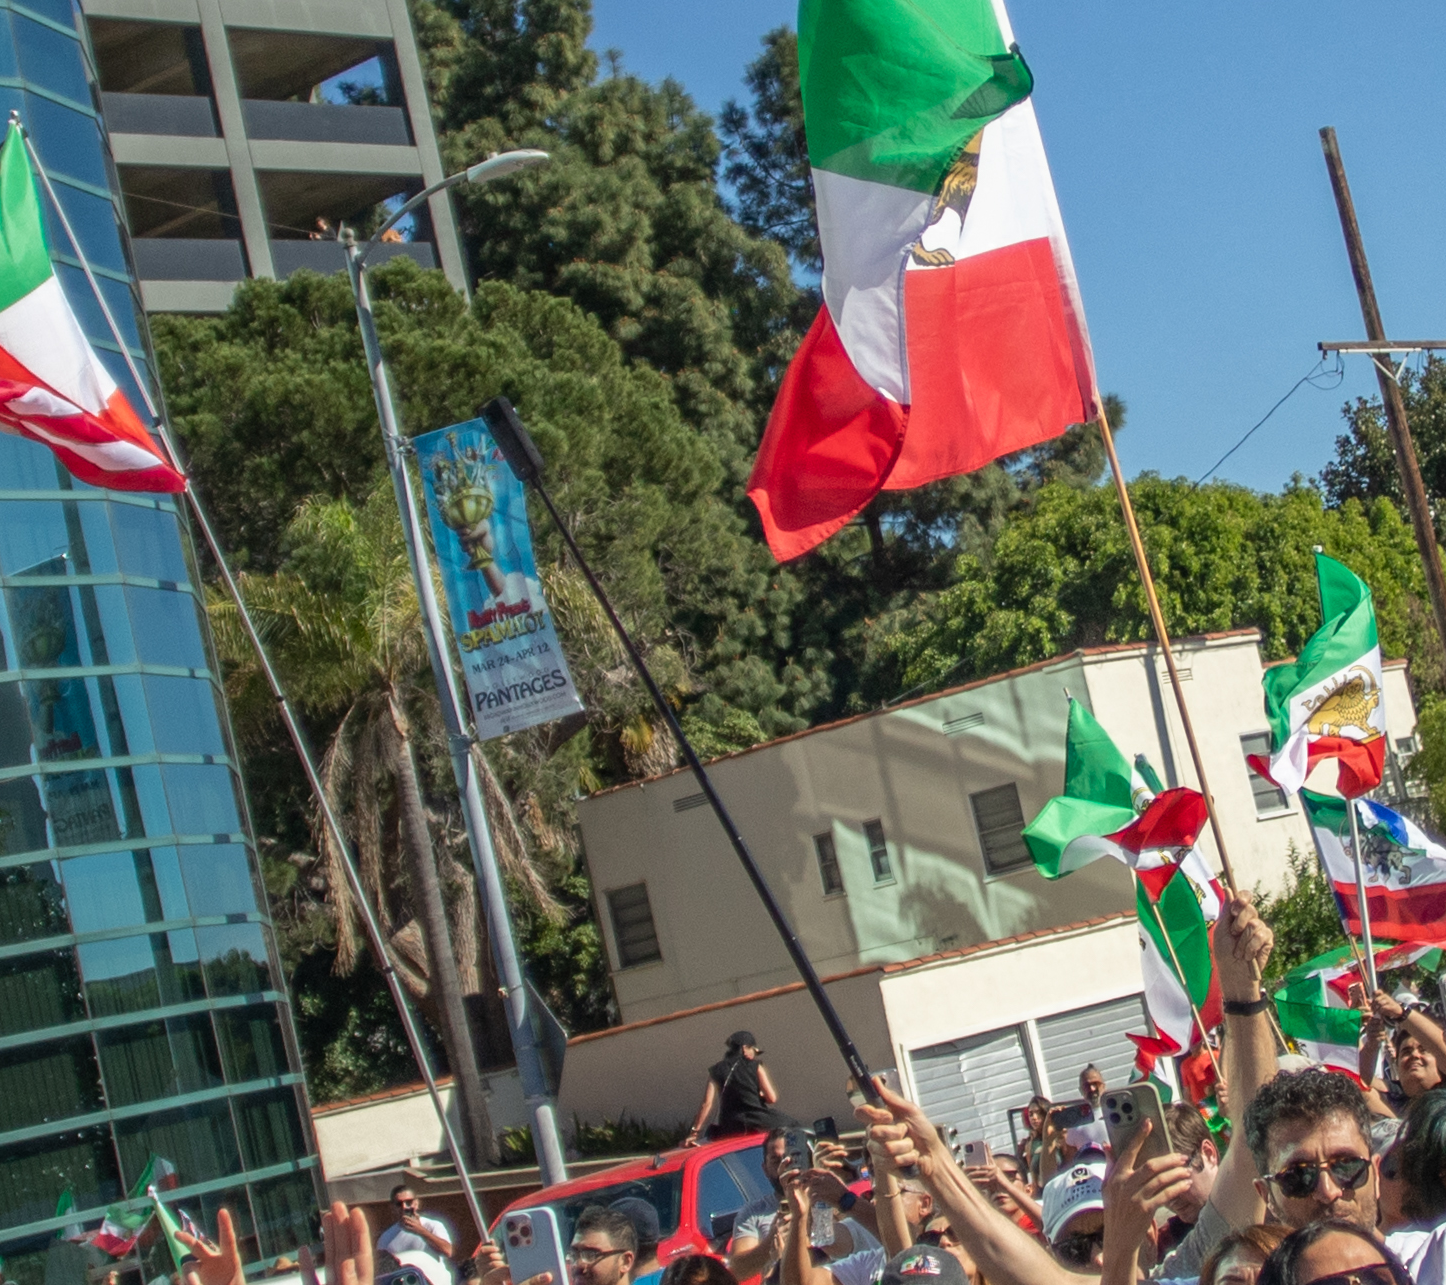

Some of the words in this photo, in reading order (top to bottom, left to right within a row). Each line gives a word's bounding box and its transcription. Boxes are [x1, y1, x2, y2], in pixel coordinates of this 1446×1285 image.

[460, 610, 546, 653] SPAMALOT
[471, 659, 496, 674] MAR
[536, 642, 551, 655] 12
[474, 669, 567, 712] PANTAGES
